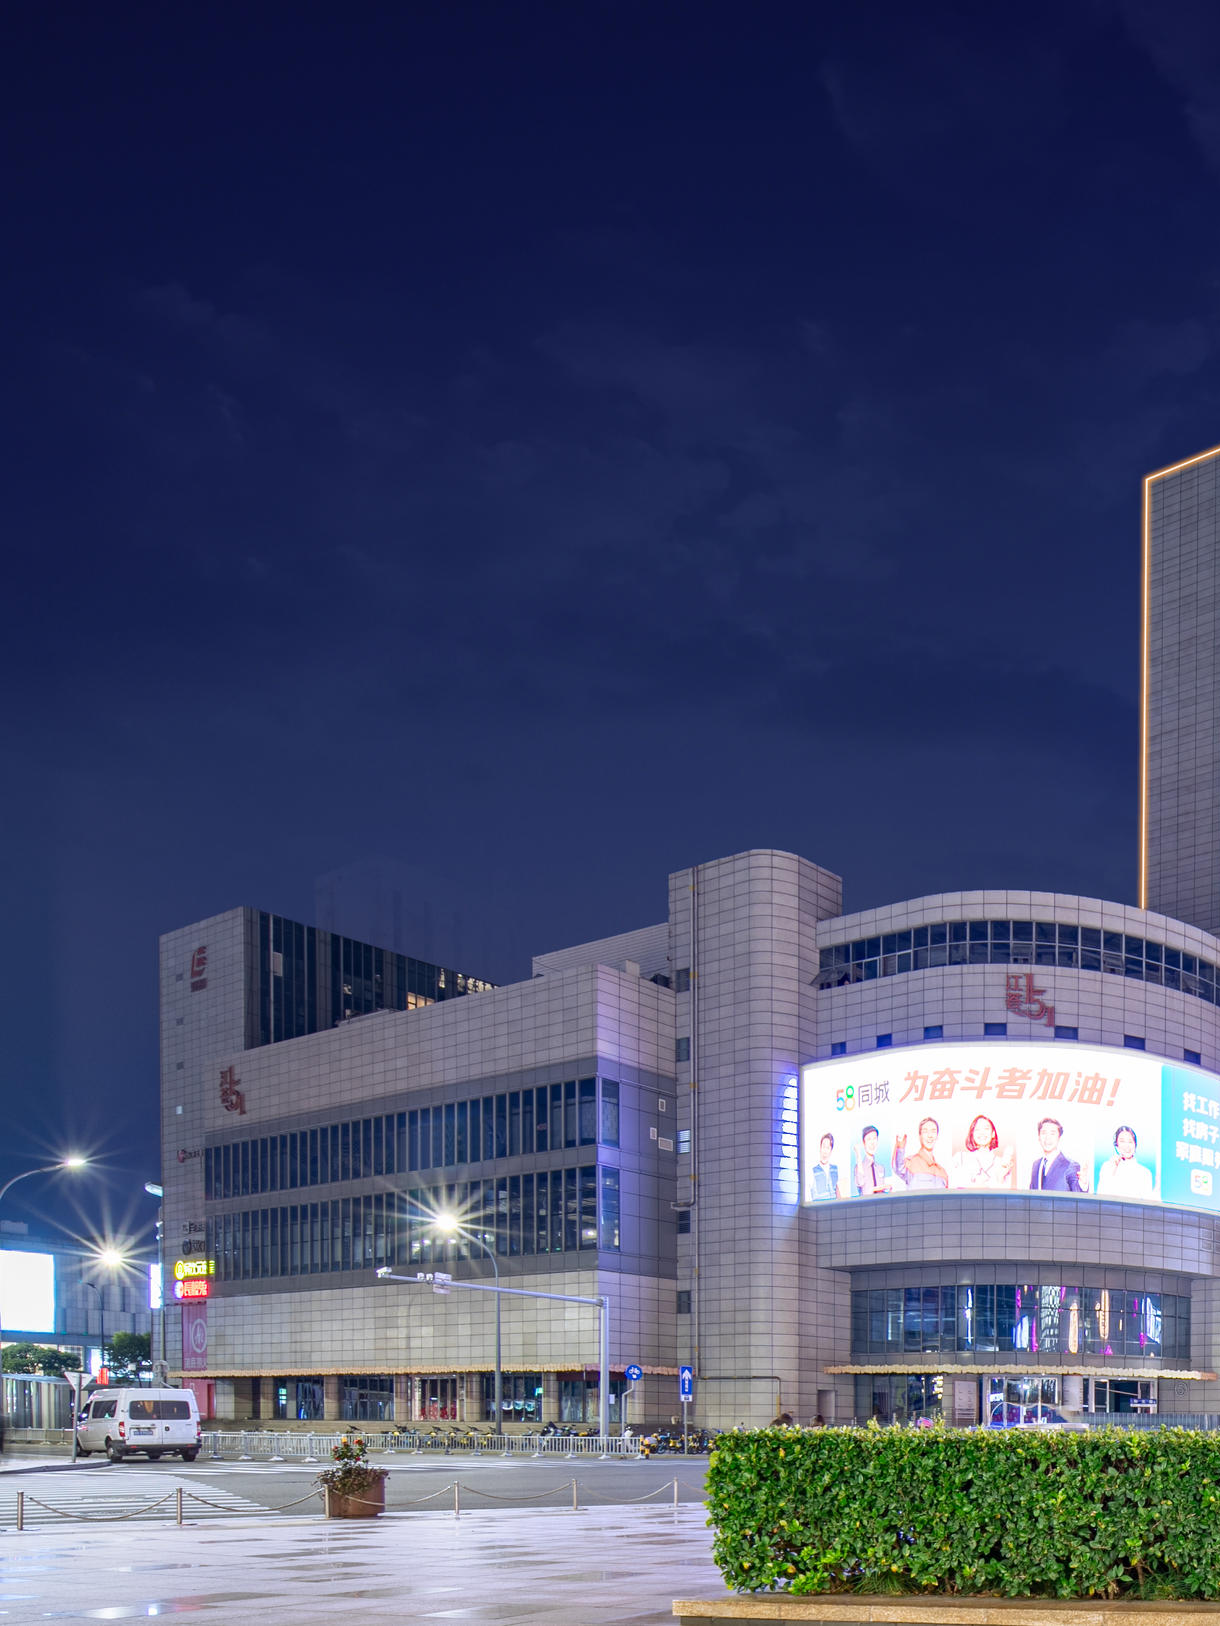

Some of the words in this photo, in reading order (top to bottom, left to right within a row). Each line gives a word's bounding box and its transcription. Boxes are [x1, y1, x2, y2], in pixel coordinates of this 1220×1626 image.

[836, 1080, 890, 1111] 58同城
[1182, 1091, 1220, 1120] 找工作
[1182, 1118, 1220, 1144] 找房子
